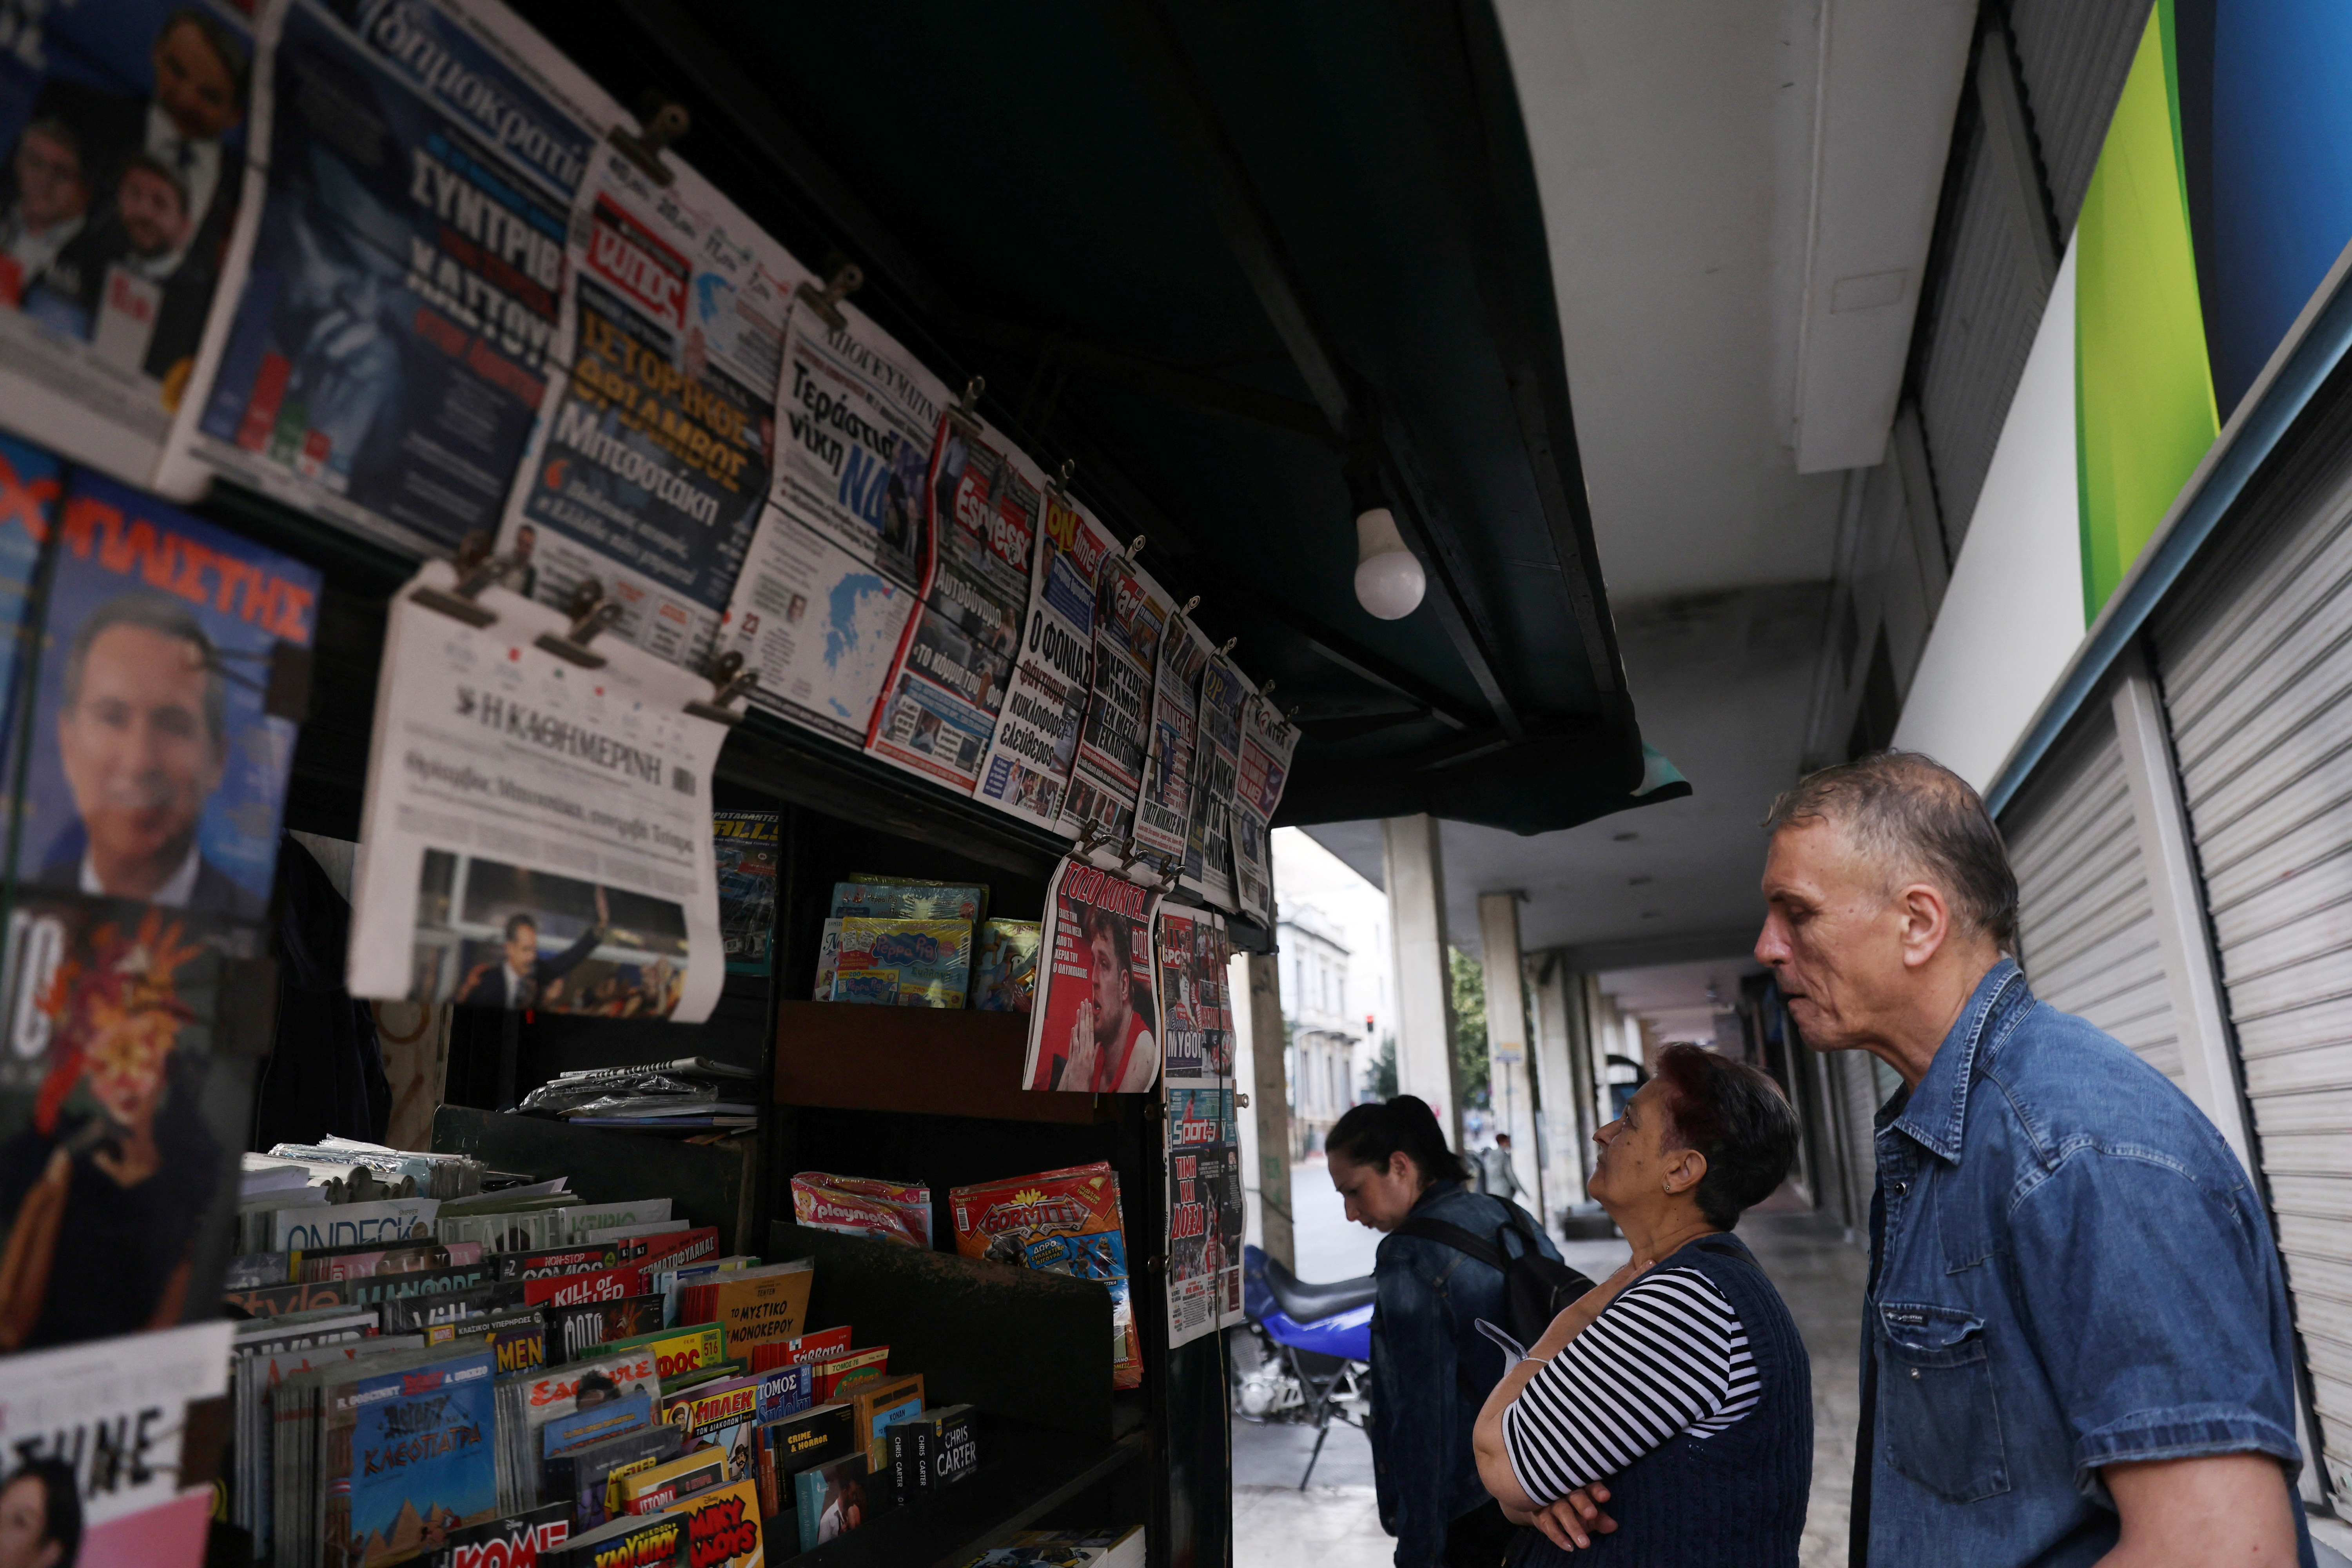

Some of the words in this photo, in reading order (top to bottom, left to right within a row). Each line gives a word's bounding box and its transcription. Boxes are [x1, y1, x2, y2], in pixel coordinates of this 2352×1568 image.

[793, 359, 895, 462] Τεράστια
[1042, 622, 1093, 688] ΦΟΝΙΑΣ
[1108, 678, 1141, 722] ΓΑΜΟΣ
[1104, 704, 1115, 728] ΕΝ
[1000, 722, 1054, 767] ελεύθερος
[1061, 861, 1104, 906] ΤΟΣΟ
[1058, 907, 1069, 918] ΕΧΑΣΕ
[1069, 911, 1078, 923] ΤΗΝ
[1058, 921, 1072, 934] ΚΟΥΠΑ
[1072, 925, 1082, 938] ΜΕΣΑ
[877, 934, 913, 960] Peppa
[916, 936, 935, 960] Pig
[1056, 935, 1066, 947] ΑΠΟ
[1067, 938, 1073, 949] ΤΑ
[1054, 949, 1069, 962] ΧΕΡΙΑ
[1069, 952, 1078, 964] ΤΟΥ
[1053, 964, 1057, 973] Ο
[1058, 964, 1088, 980] ΟΛΥΜΠΙΑΚΟΣ
[848, 979, 870, 992] Peppa
[871, 981, 882, 993] Pig
[1176, 1155, 1197, 1180] ΤΙΜΗ
[1180, 1180, 1196, 1203] ΚΑΙ
[817, 1203, 898, 1229] playmob
[984, 1200, 1080, 1232] GORMITI
[1171, 1203, 1204, 1239] ΔΟΞΑ
[1031, 1245, 1065, 1262] ΣΥΛΛΕΚΤΙΚΗ
[1033, 1240, 1058, 1254] ΔΩΡΟ
[545, 1253, 585, 1266] NON-STOP
[554, 1280, 592, 1307] KILL
[757, 1288, 775, 1297] ΤΕΝΤΕΝ
[731, 1308, 739, 1317] ΤΟ
[740, 1300, 788, 1321] ΜΥΣΤΙΚΟ
[434, 1327, 452, 1341] MARVEL
[458, 1324, 490, 1335] ΚΛΑΣΙΚΟΙ
[491, 1315, 532, 1330] ΥΠΕΡΗΡΩΕΣ
[731, 1318, 793, 1344] ΜΟΝΟΚΕΡΟΥ
[704, 1332, 717, 1341] ΤΟΜΟΣ
[704, 1342, 718, 1356] 516
[832, 1361, 852, 1372] ΤΟΜΟΣ
[757, 1374, 797, 1401] ΤΟΜΟΣ
[696, 1388, 754, 1425] ΜΠΛΕΚ
[758, 1391, 811, 1425] Sudoku
[889, 1408, 906, 1422] KONAN
[696, 1426, 708, 1436] ΤΩΝ
[710, 1416, 739, 1433] ΔΙΑΚΟΠΩΝ
[945, 1425, 968, 1449] CHRIS
[364, 1421, 482, 1476] ΚΛΕΟΠΑΤΡΑ
[788, 1430, 811, 1445] CRIME
[791, 1444, 797, 1453] &
[798, 1434, 828, 1450] HORROR
[936, 1441, 976, 1477] CARTER
